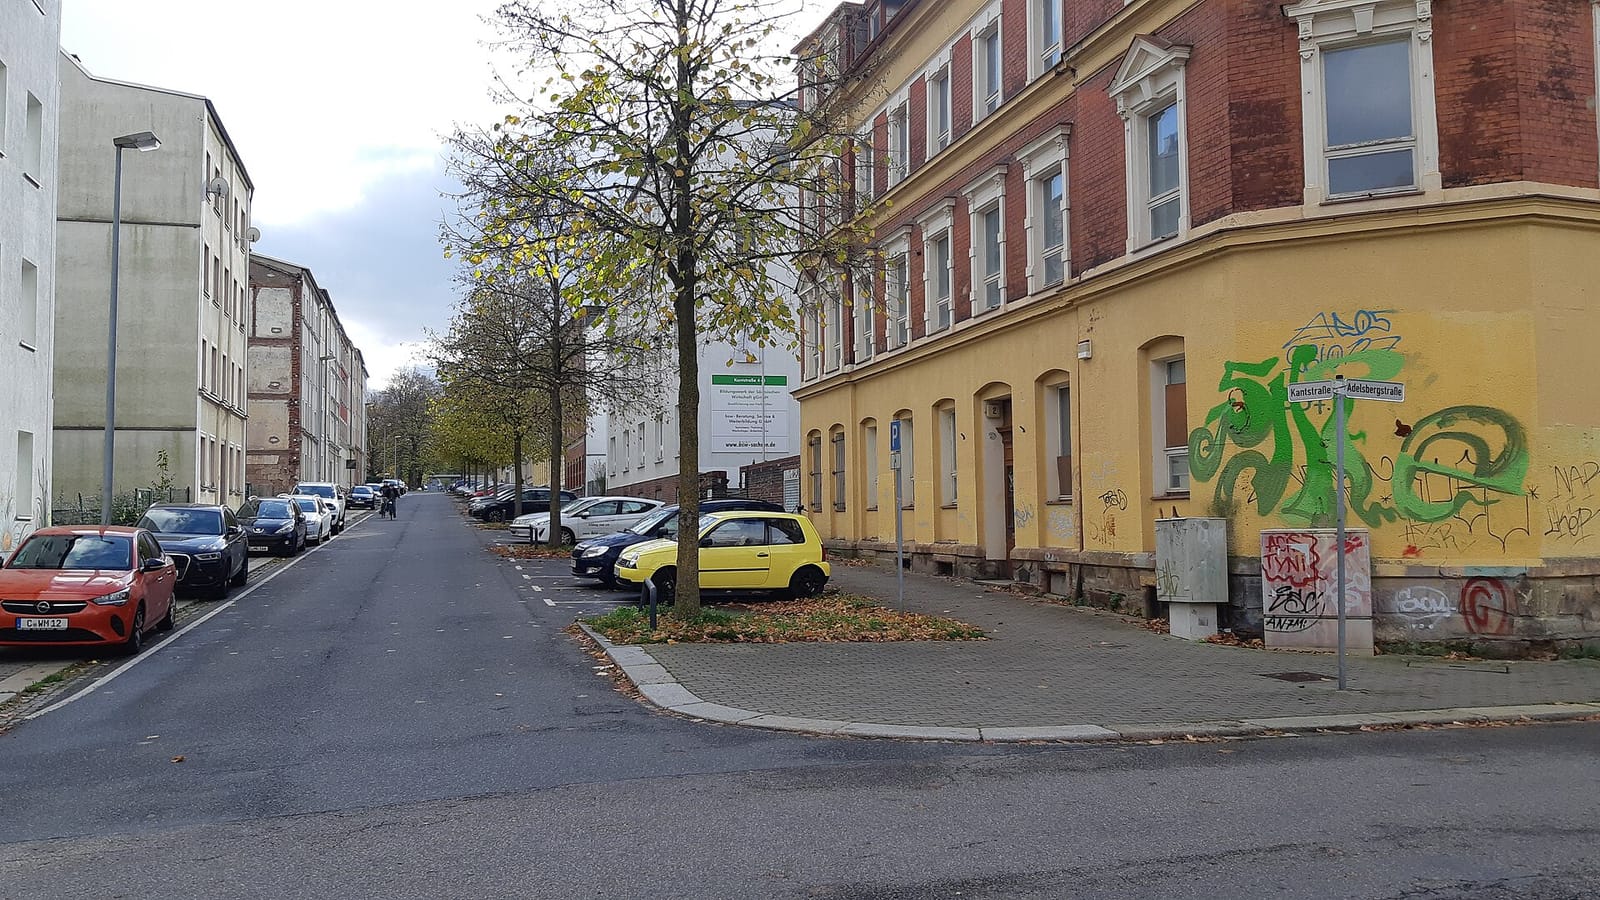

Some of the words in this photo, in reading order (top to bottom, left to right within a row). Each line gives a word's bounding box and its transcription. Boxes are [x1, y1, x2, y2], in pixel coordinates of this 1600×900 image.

[1290, 385, 1332, 397] Kantstraße
[1347, 383, 1402, 396] Adelsbergstraße
[26, 619, 33, 628] C
